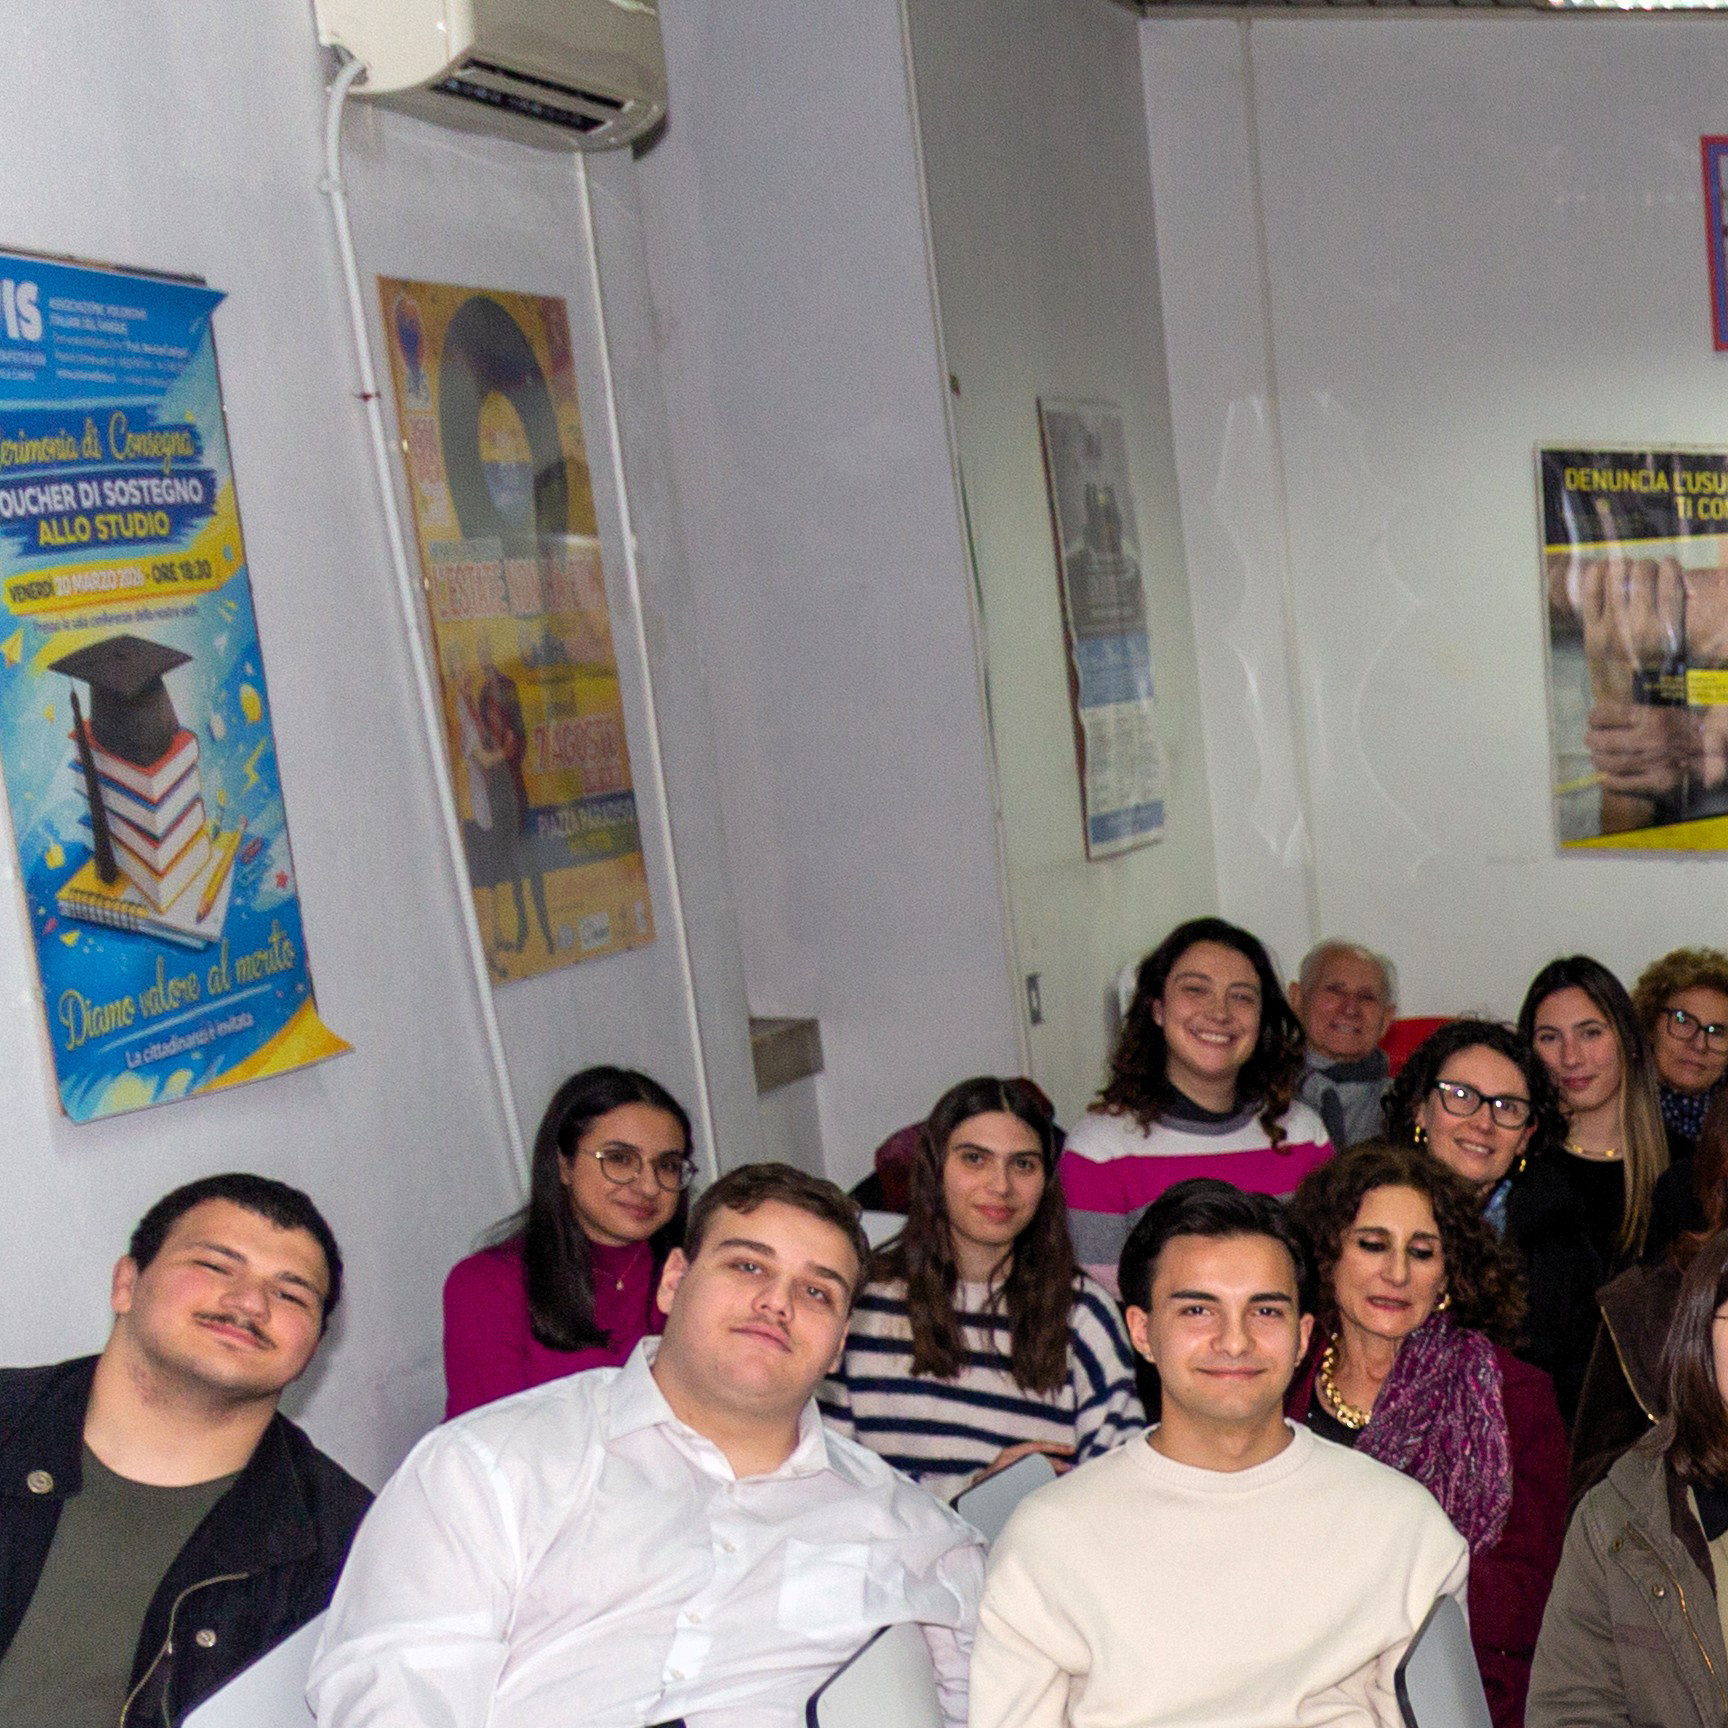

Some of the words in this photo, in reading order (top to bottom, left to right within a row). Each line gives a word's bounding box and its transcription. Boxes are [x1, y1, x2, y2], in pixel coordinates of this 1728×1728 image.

[0, 427, 79, 467] erimonia
[82, 416, 101, 459] di
[109, 410, 194, 475] Consegna
[78, 481, 100, 509] DI
[103, 477, 204, 507] SOSTEGNO
[1565, 467, 1669, 493] DENUNCIA
[1676, 497, 1696, 520] TI
[38, 515, 92, 547] ALLO
[95, 511, 170, 541] STUDIO
[71, 571, 118, 594] MARZO
[152, 562, 178, 584] ORE
[59, 989, 135, 1051] Diamo
[140, 956, 200, 1019] valore
[207, 940, 231, 995] al
[235, 919, 296, 982] merito
[125, 1048, 142, 1069] La
[143, 1027, 206, 1065] cittadinanza
